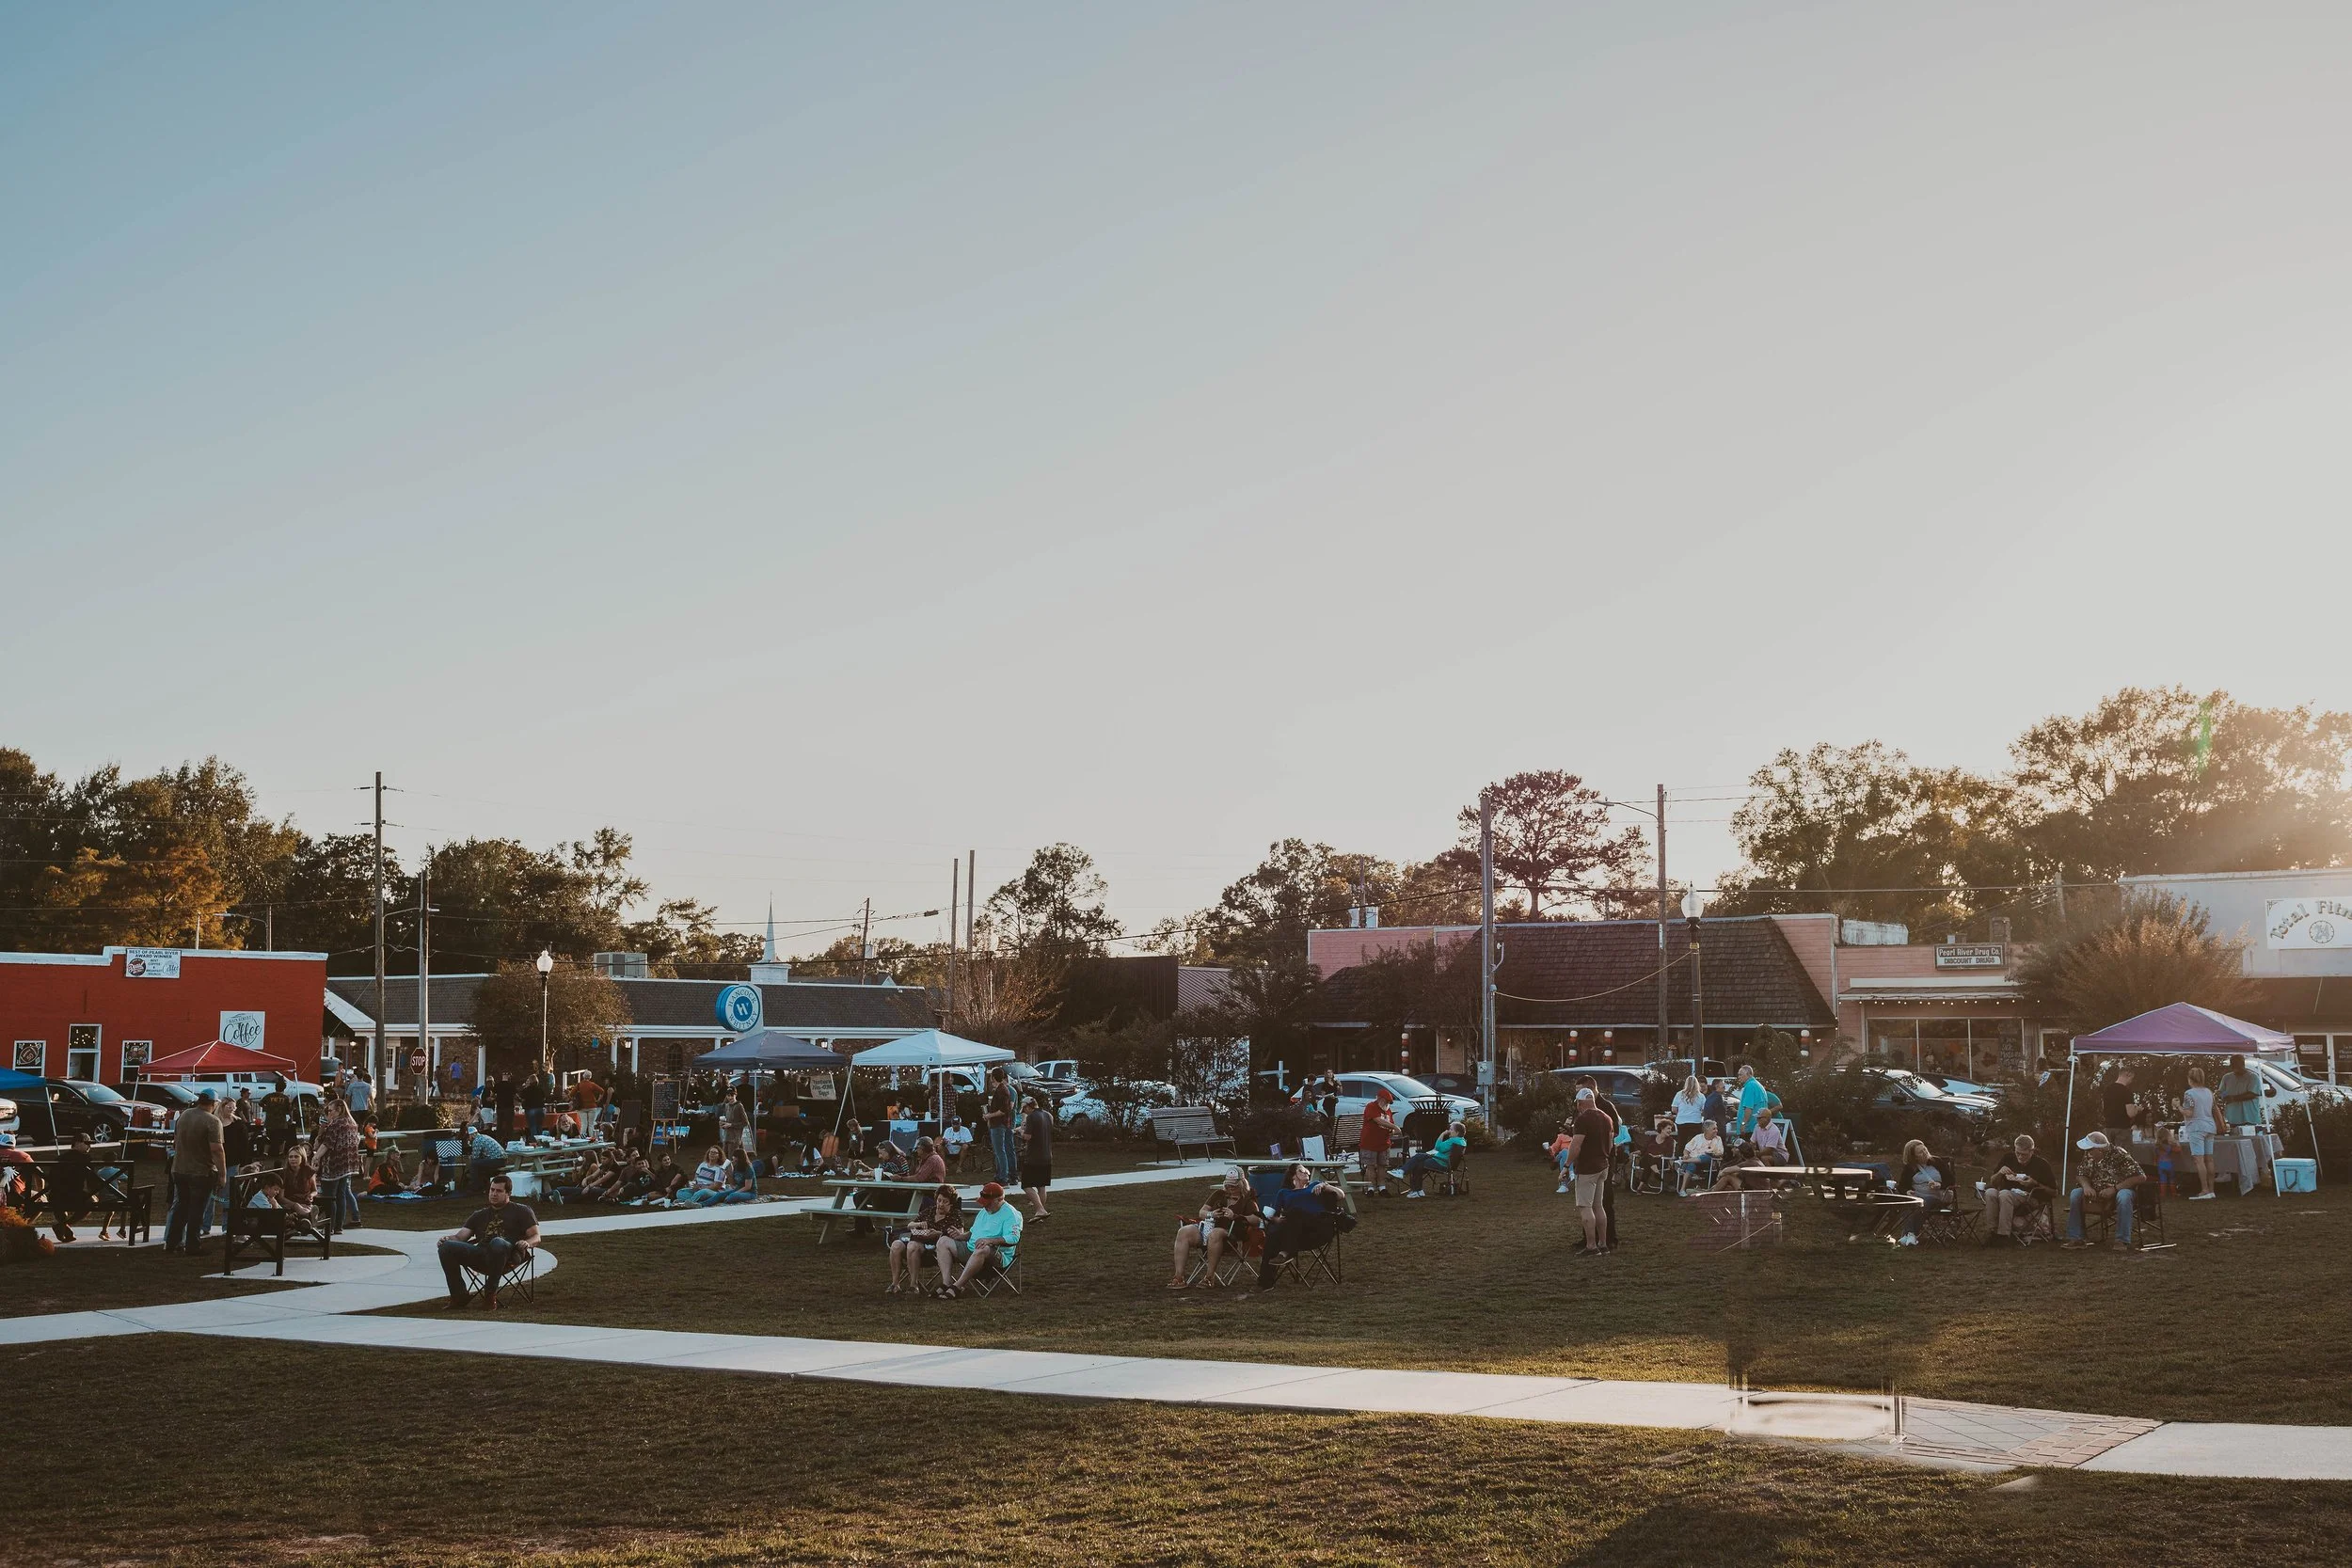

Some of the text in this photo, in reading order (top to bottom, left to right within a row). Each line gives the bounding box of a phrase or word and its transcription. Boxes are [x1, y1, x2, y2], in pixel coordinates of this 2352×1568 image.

[2269, 903, 2310, 939] Total
[1939, 948, 1955, 957] Pearl
[1991, 947, 2000, 956] Co.
[728, 990, 757, 1007] HANCOCK
[729, 1011, 757, 1028] WHITNEY
[223, 1022, 262, 1043] Coffee
[411, 1055, 426, 1067] STOP
